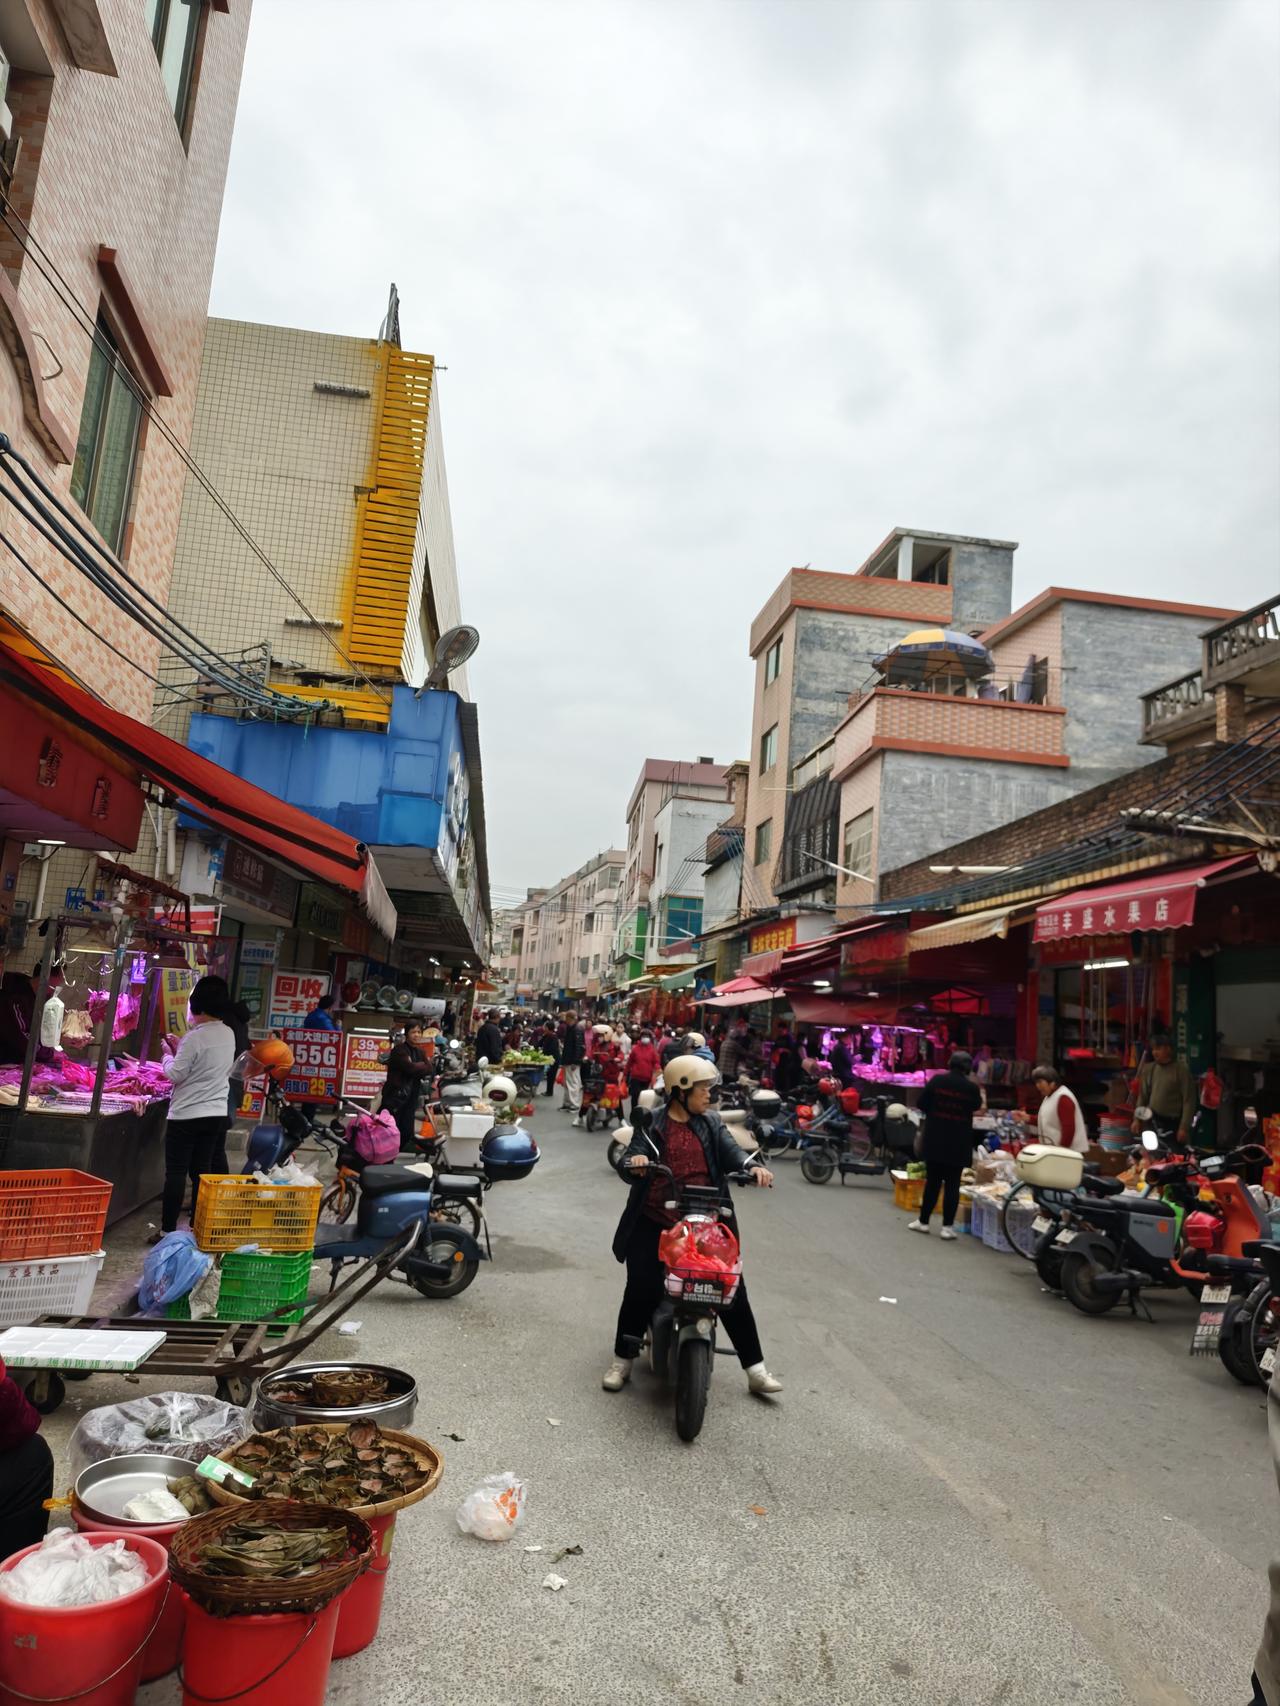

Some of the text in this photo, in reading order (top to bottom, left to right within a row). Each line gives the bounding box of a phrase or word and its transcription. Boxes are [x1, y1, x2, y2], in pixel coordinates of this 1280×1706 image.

[1062, 898, 1169, 932] 丰盛水果店
[275, 976, 324, 999] 回收
